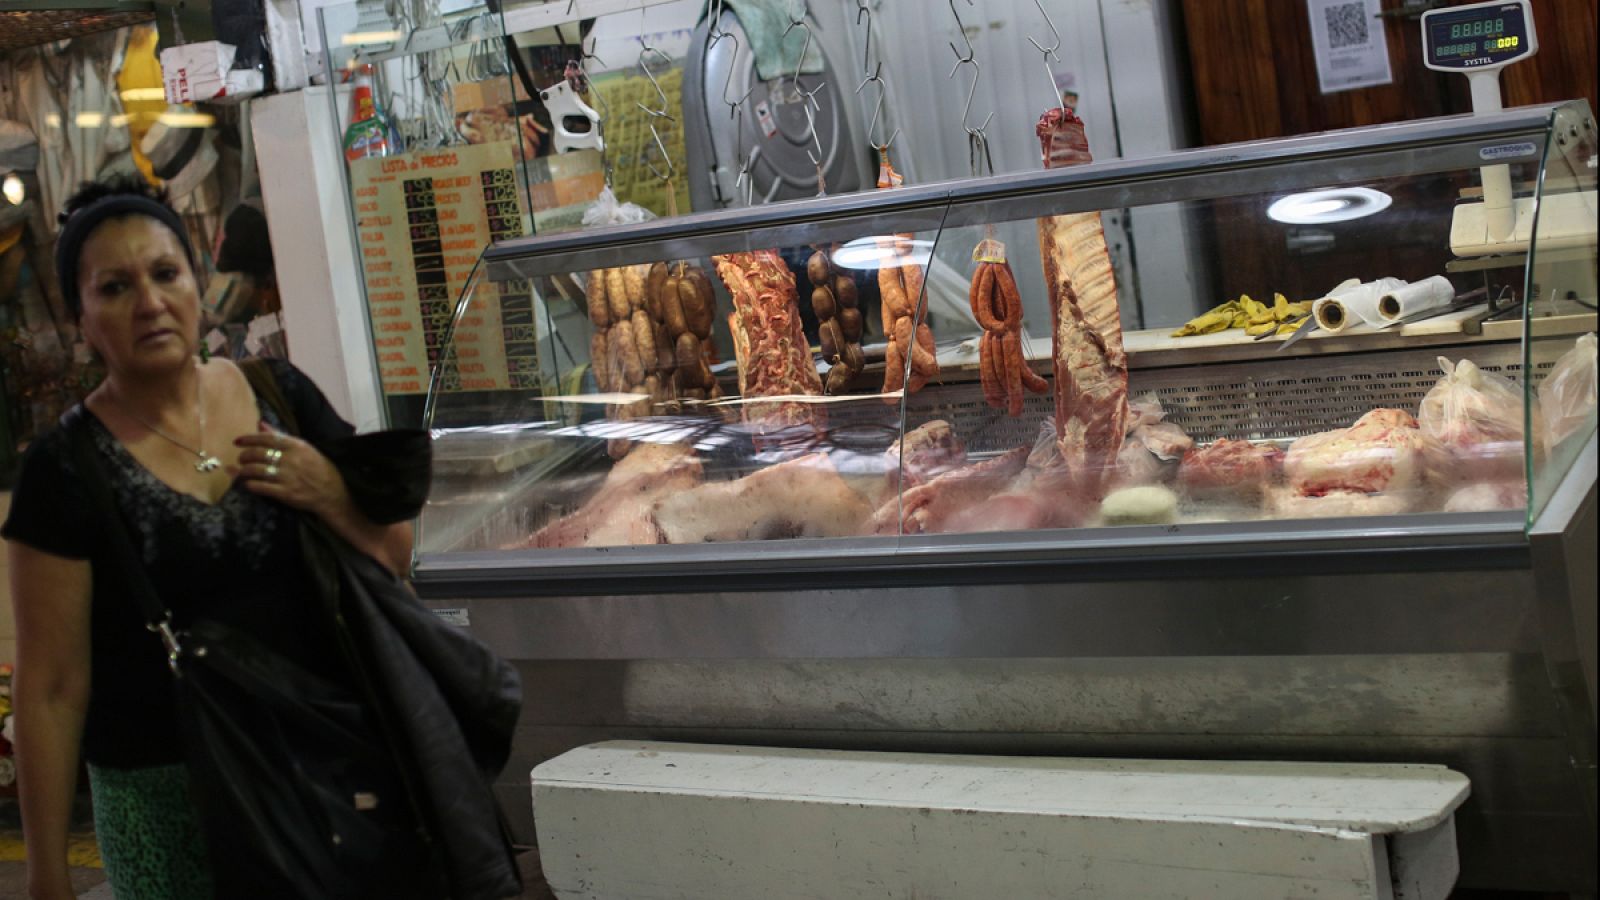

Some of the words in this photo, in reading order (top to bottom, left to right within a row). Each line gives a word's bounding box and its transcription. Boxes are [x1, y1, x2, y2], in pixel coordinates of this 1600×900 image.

[1464, 57, 1492, 66] SYSTEL
[382, 160, 407, 173] LISTA
[421, 152, 458, 168] PRECIOS
